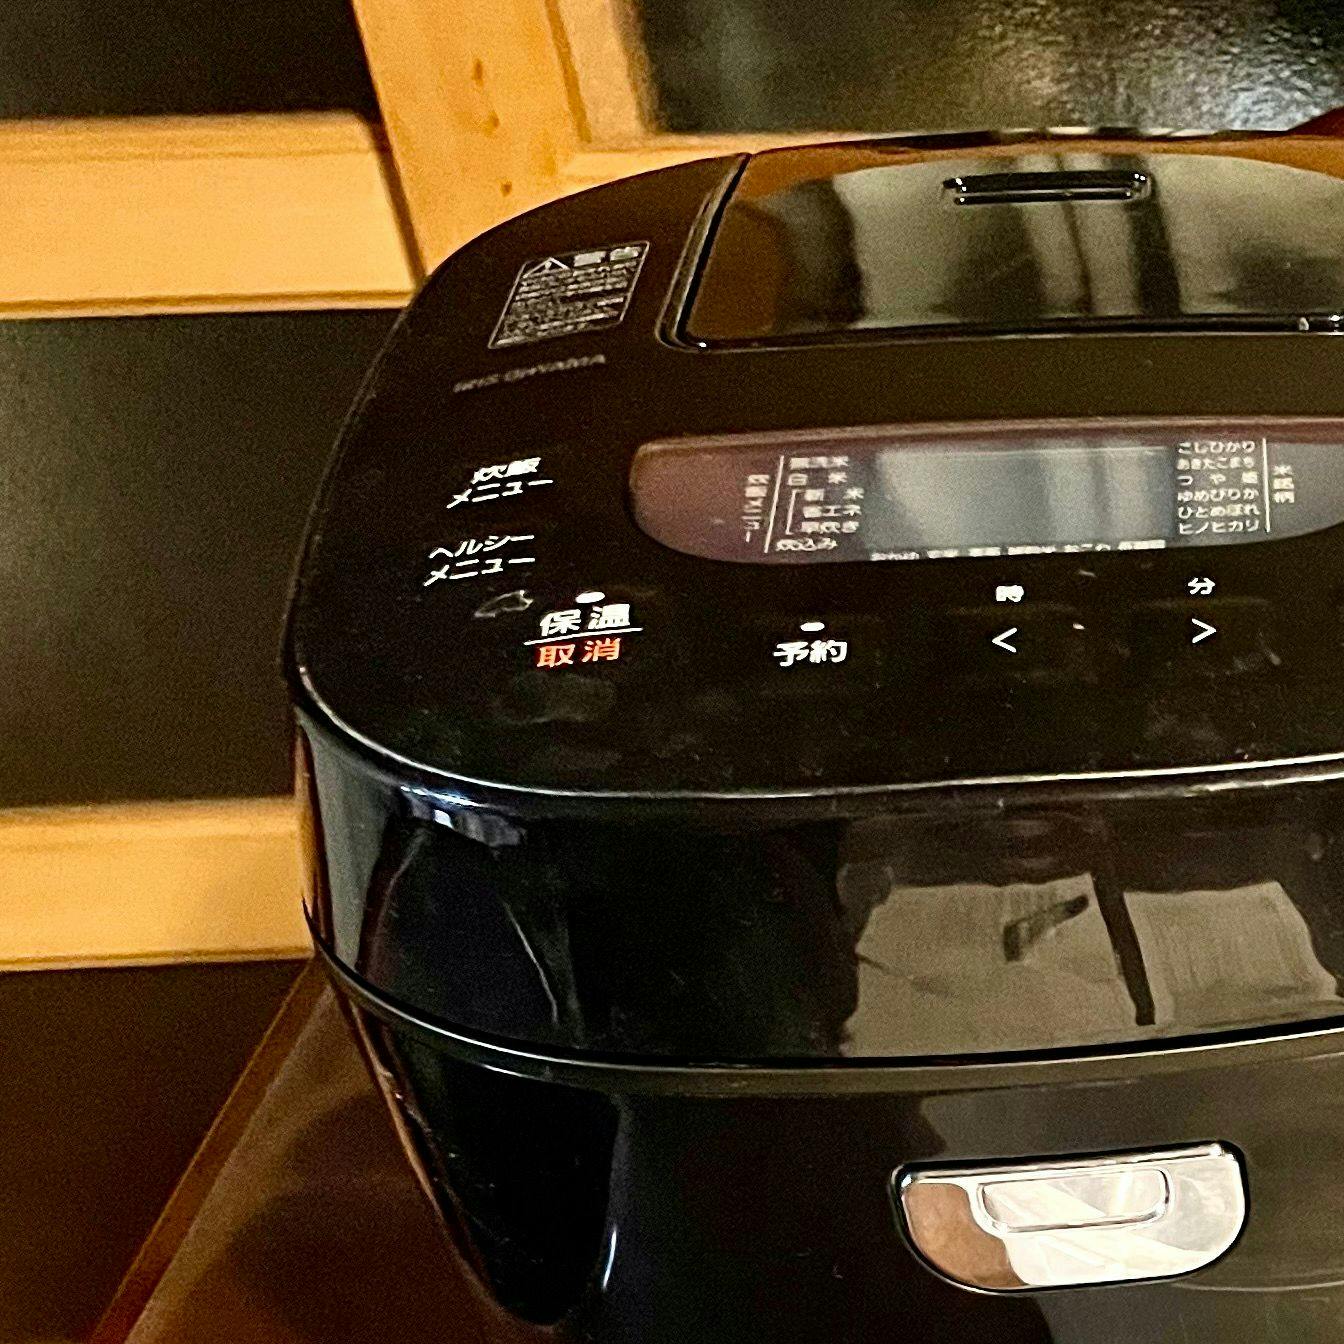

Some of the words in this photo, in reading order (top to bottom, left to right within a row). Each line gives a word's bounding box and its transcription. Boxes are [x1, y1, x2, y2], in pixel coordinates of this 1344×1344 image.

[446, 479, 554, 509] メニュー
[1179, 520, 1259, 535] ヒノヒカリ
[429, 534, 535, 560] ヘルシー
[424, 558, 535, 586] メニュー
[1188, 577, 1216, 596] 分
[540, 603, 631, 638] 保温
[536, 637, 622, 669] 取消
[773, 639, 848, 667] 予約
